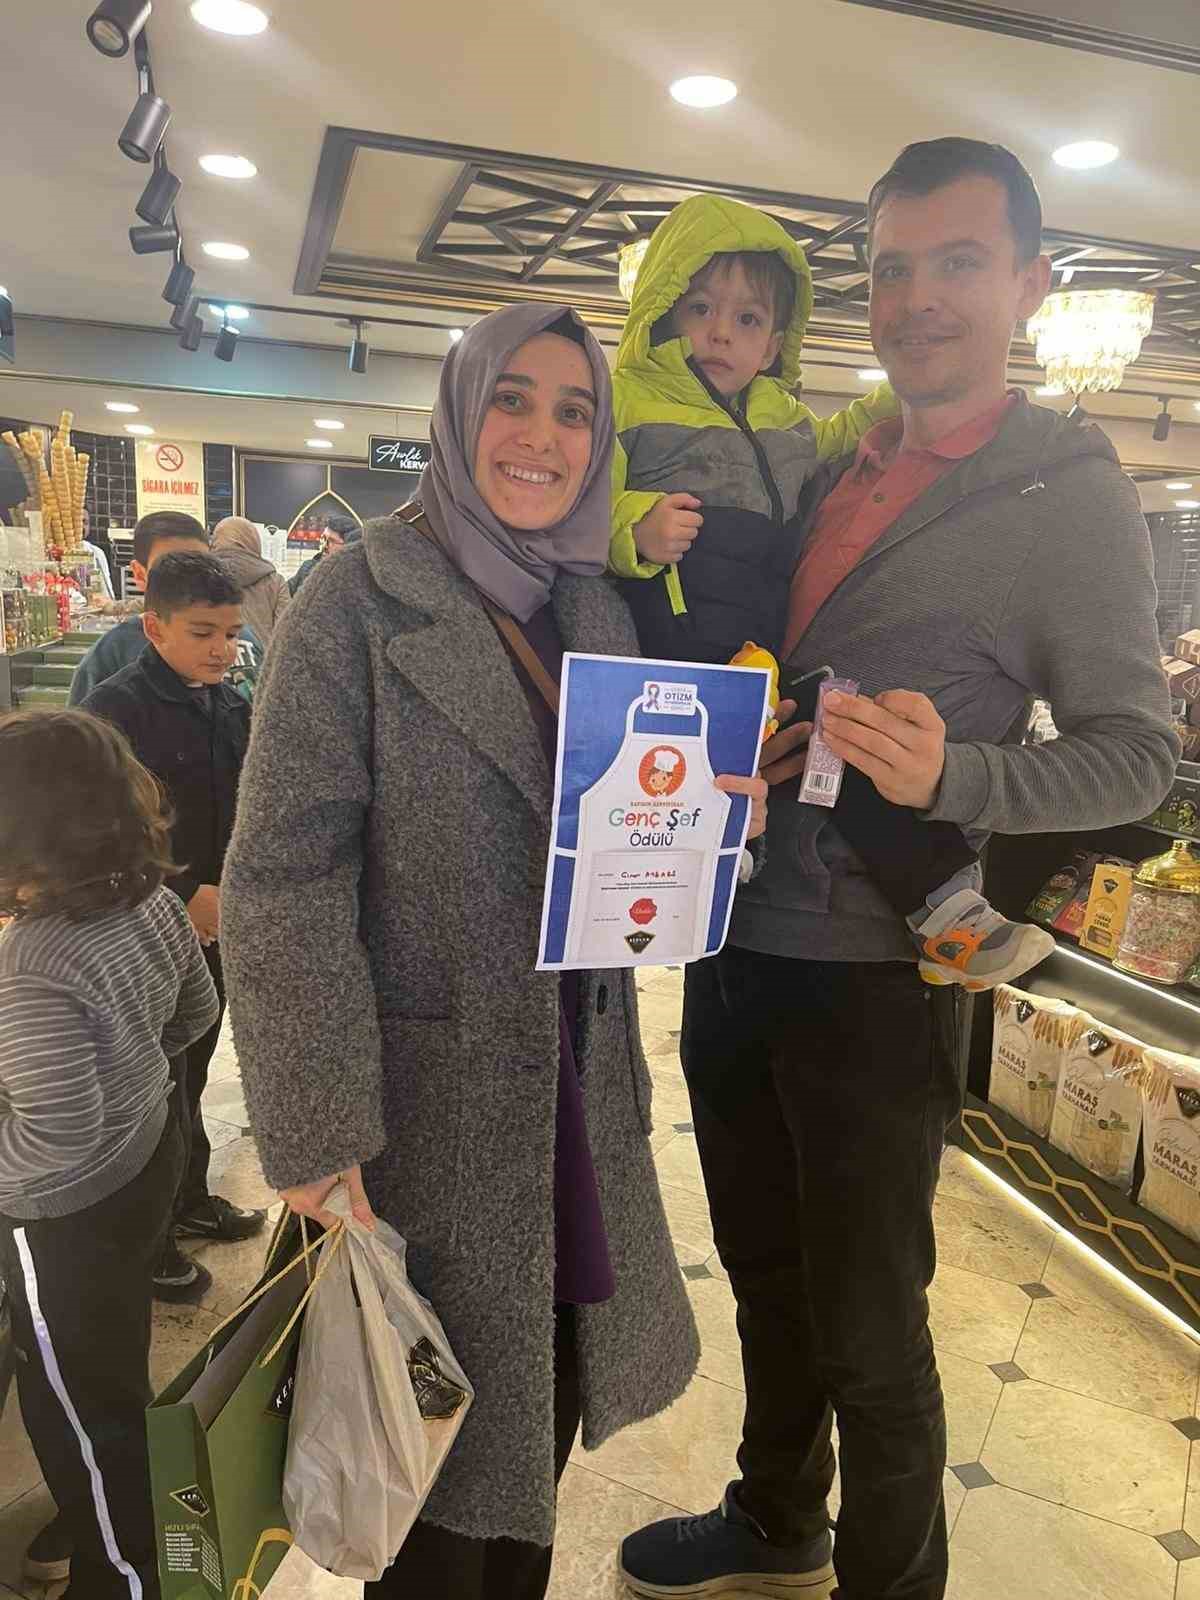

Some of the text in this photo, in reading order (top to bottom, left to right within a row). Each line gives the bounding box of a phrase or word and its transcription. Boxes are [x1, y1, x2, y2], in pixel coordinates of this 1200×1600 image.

[608, 808, 702, 831] Genç Şef
[630, 829, 674, 847] Ödülü
